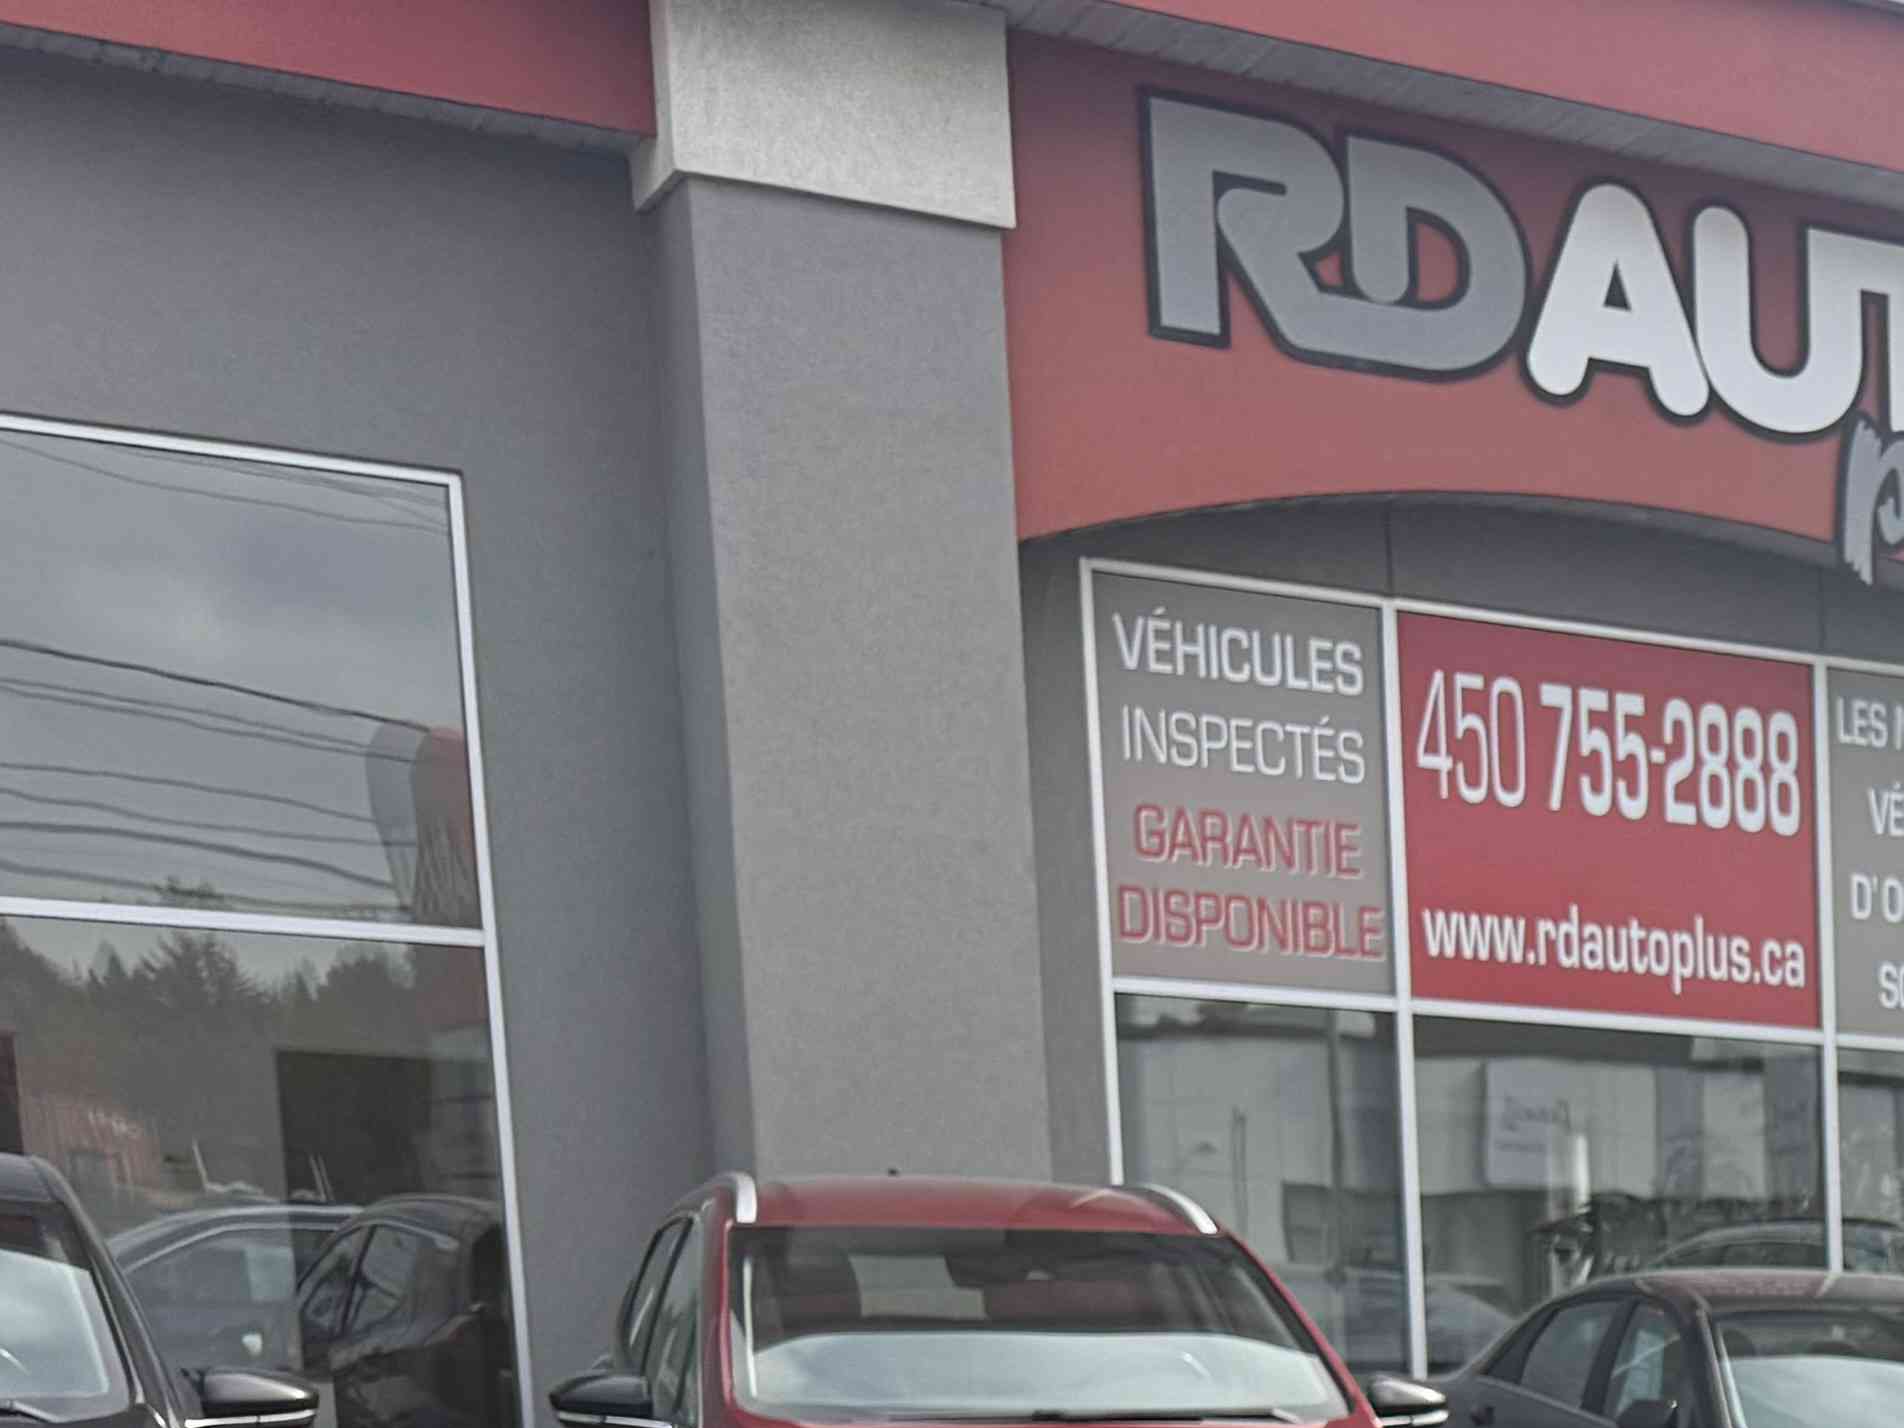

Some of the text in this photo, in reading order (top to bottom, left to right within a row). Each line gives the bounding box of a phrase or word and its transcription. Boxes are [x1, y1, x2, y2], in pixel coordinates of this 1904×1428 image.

[1112, 606, 1364, 696] VÉHICULES
[1121, 705, 1366, 784] INSPECTÉS
[1417, 669, 1801, 837] 450 755-2888
[1836, 696, 1888, 749] LES
[1133, 803, 1363, 880] GARANTIE
[1117, 883, 1386, 962] DISPONIBLE
[1421, 903, 1806, 996] www.rdautoplus.ca
